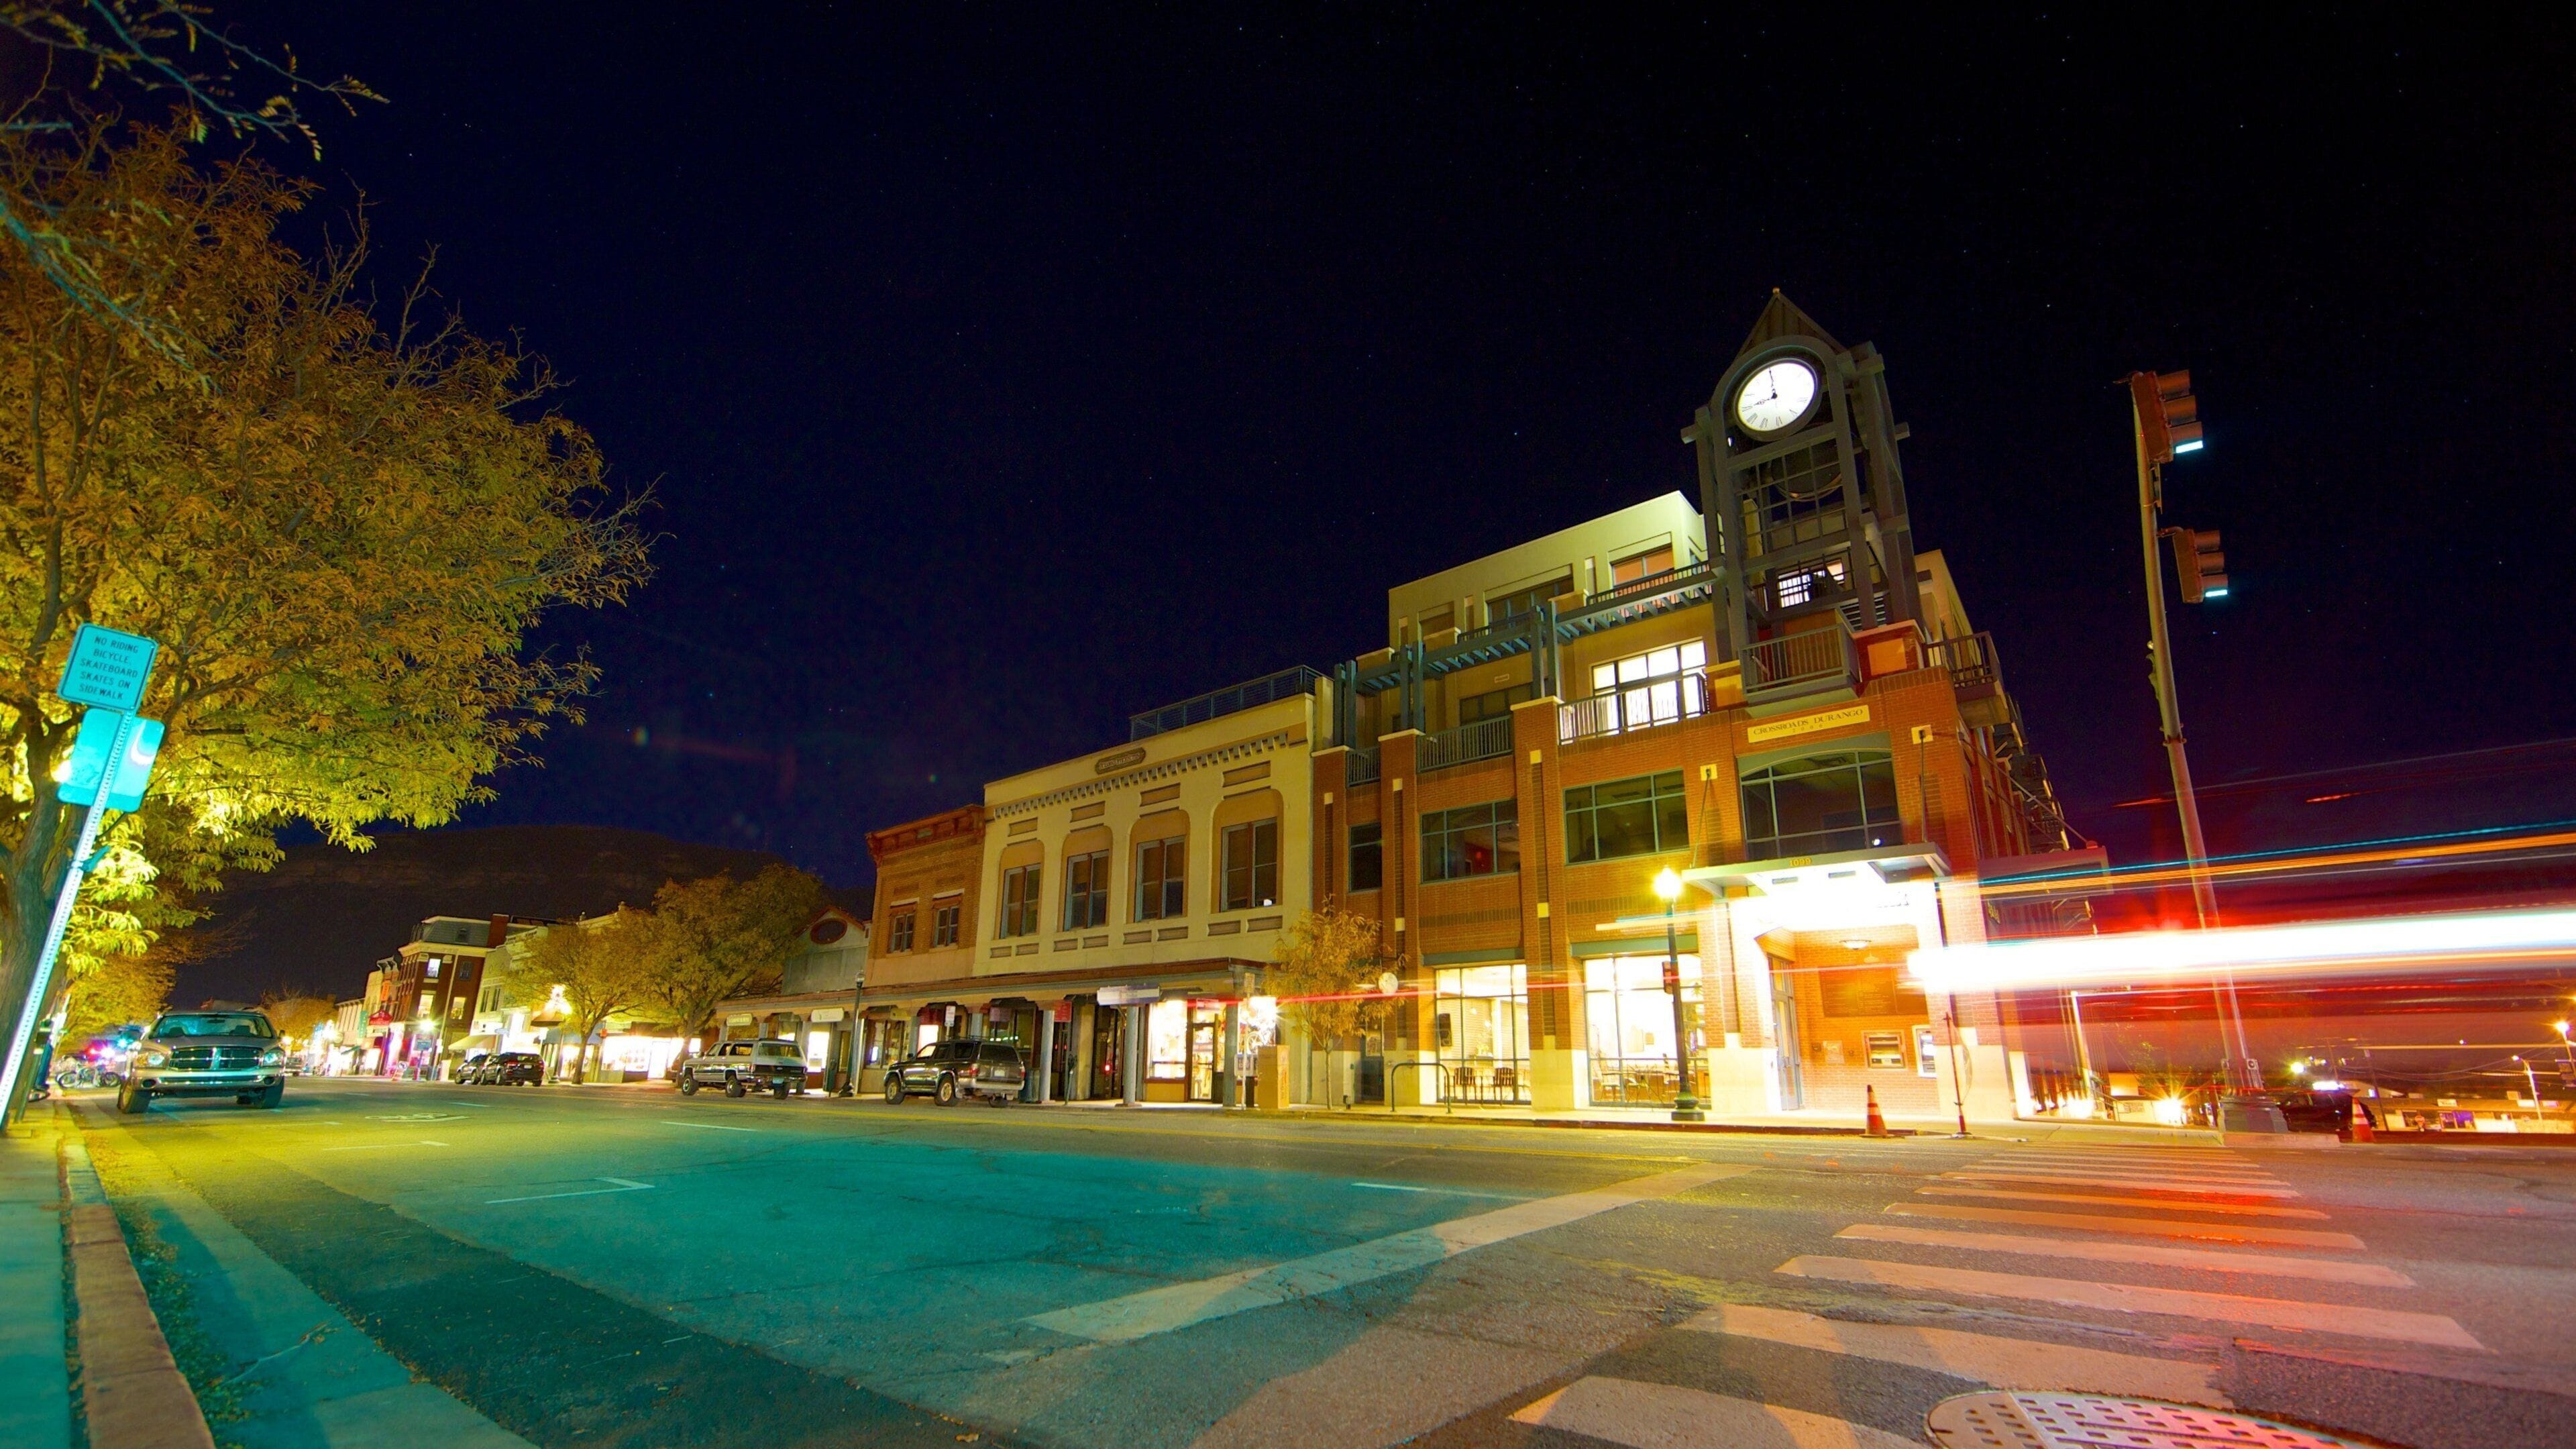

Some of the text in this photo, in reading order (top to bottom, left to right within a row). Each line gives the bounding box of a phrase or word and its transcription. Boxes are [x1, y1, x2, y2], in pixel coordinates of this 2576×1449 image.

[94, 636, 139, 654] NO RIDING
[93, 648, 129, 663] BICYCLE
[80, 658, 138, 678] SKATEBOARD
[80, 671, 131, 690] SKATES ON
[78, 684, 124, 700] SIDEWALK
[1753, 708, 1864, 735] CROSSROADS DURANGO
[1789, 856, 1813, 867] 1099
